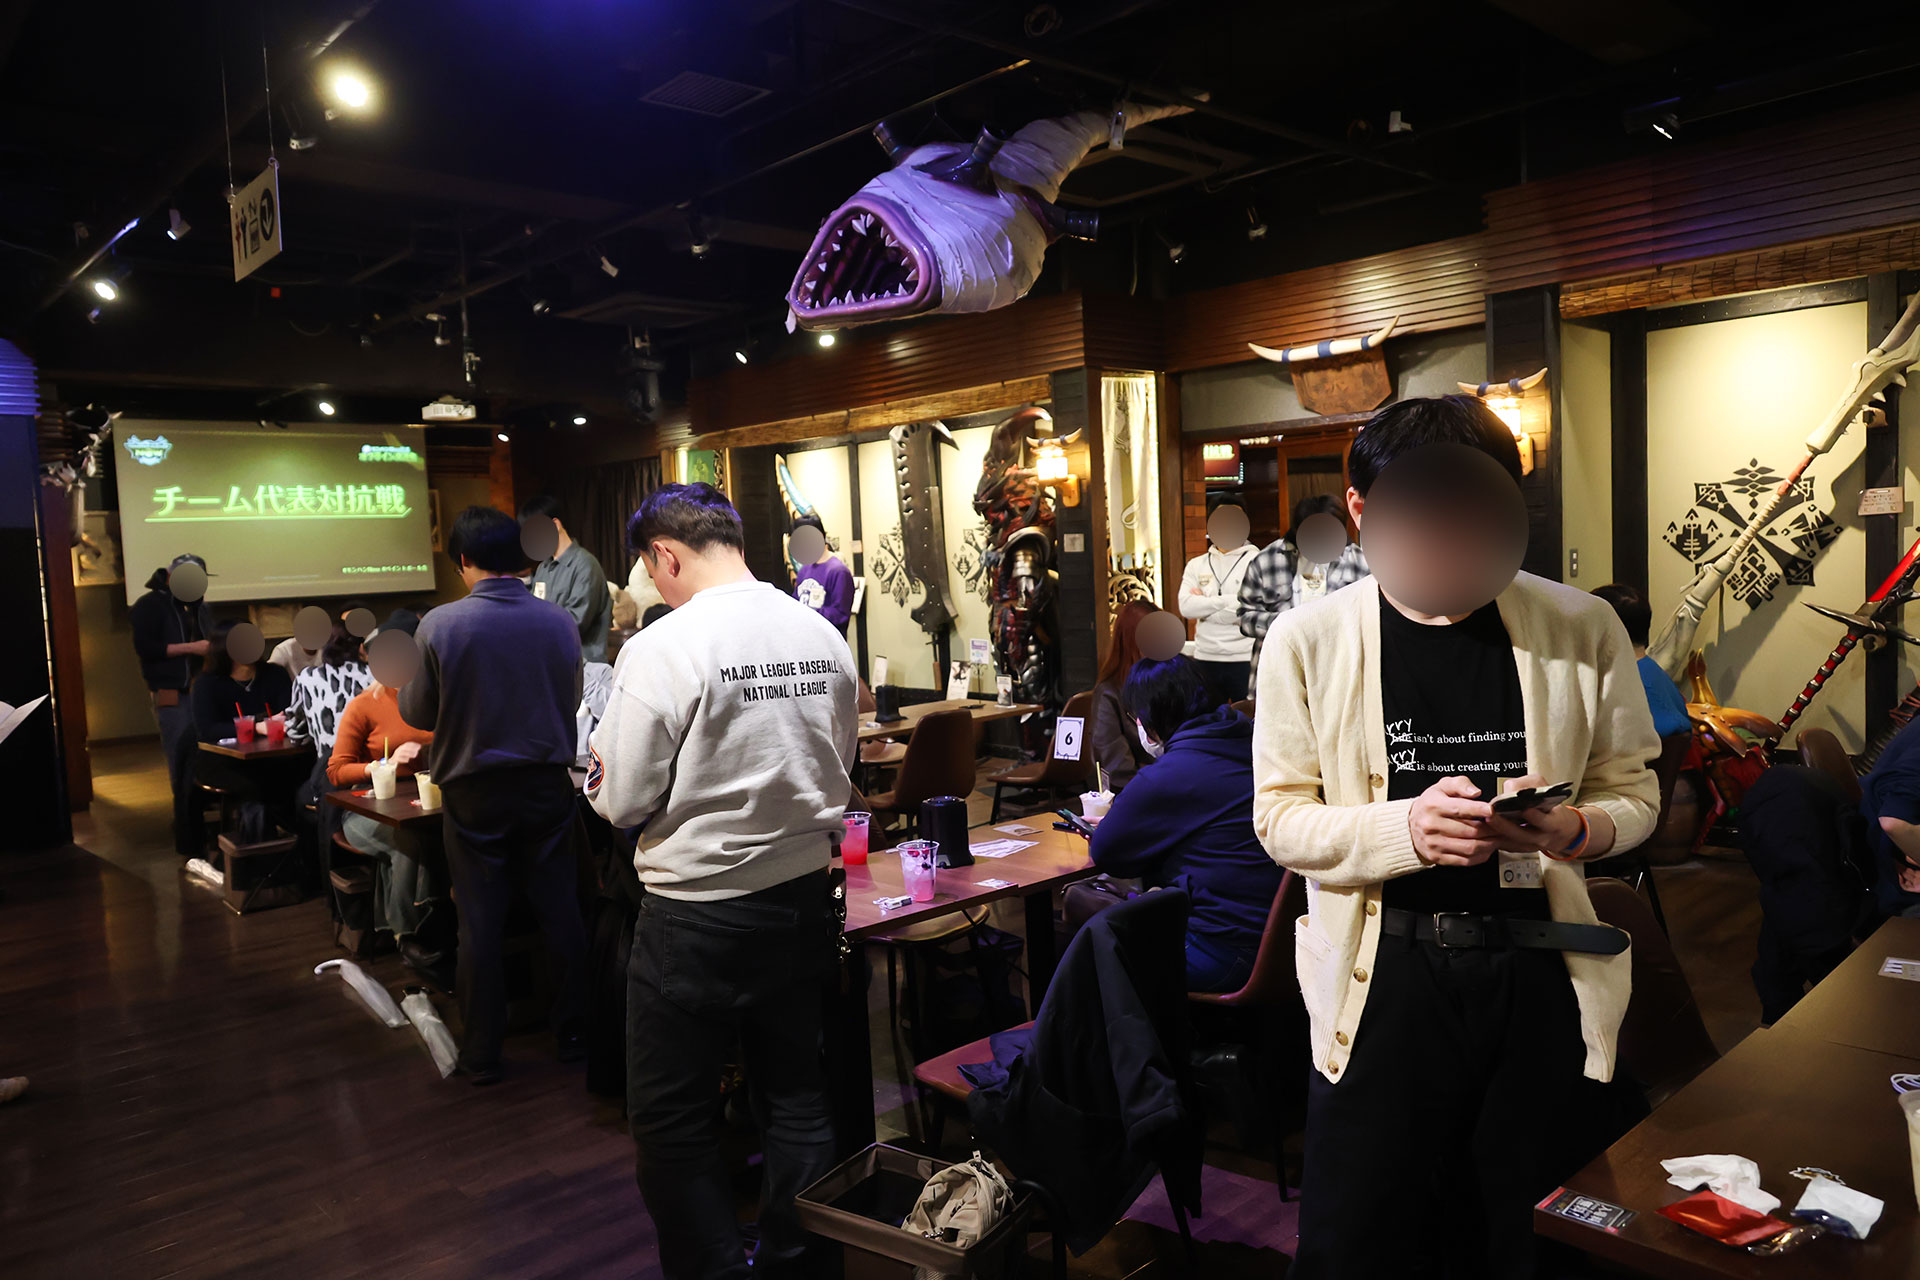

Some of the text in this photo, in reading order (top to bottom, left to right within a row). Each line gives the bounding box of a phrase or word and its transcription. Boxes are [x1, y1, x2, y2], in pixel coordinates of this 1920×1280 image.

[152, 484, 406, 516] チーム代表対抗戦
[720, 665, 758, 682] MAJOR
[760, 662, 797, 678] LEAGUE
[743, 681, 827, 702] NATIONAL LEAGUE
[1065, 731, 1073, 745] 6
[1413, 732, 1434, 744] isn't
[1436, 733, 1466, 744] about
[1468, 731, 1506, 743] finding
[1416, 761, 1426, 771] is
[1427, 761, 1456, 772] about
[1457, 760, 1501, 773] creating
